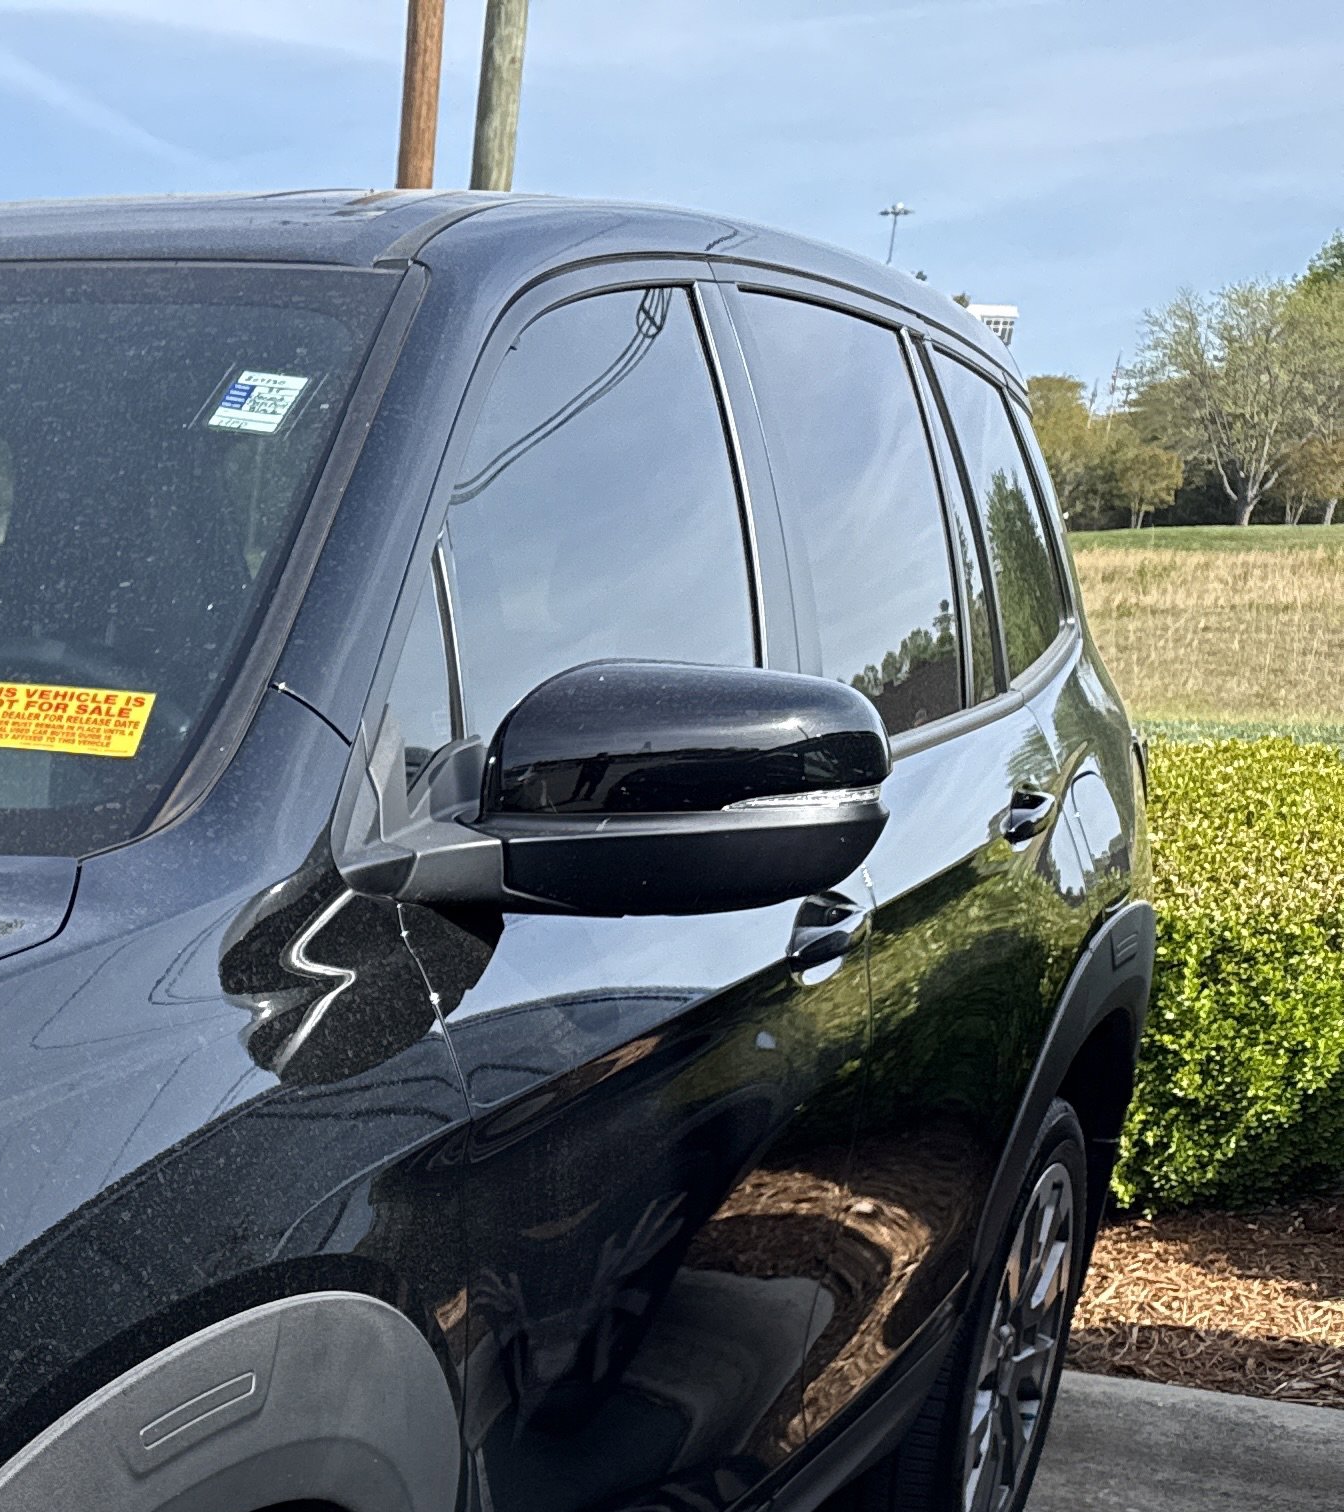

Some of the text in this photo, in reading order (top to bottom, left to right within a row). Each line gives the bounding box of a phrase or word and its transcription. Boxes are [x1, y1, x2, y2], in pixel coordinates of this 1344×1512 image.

[24, 688, 118, 704] VEHICLE
[125, 695, 146, 707] IS
[24, 700, 68, 713] FOR
[75, 703, 132, 718] SALE
[2, 711, 40, 720] DEALER
[43, 713, 63, 722] FOR
[66, 715, 111, 726] RELEASE
[114, 719, 139, 729] DATE
